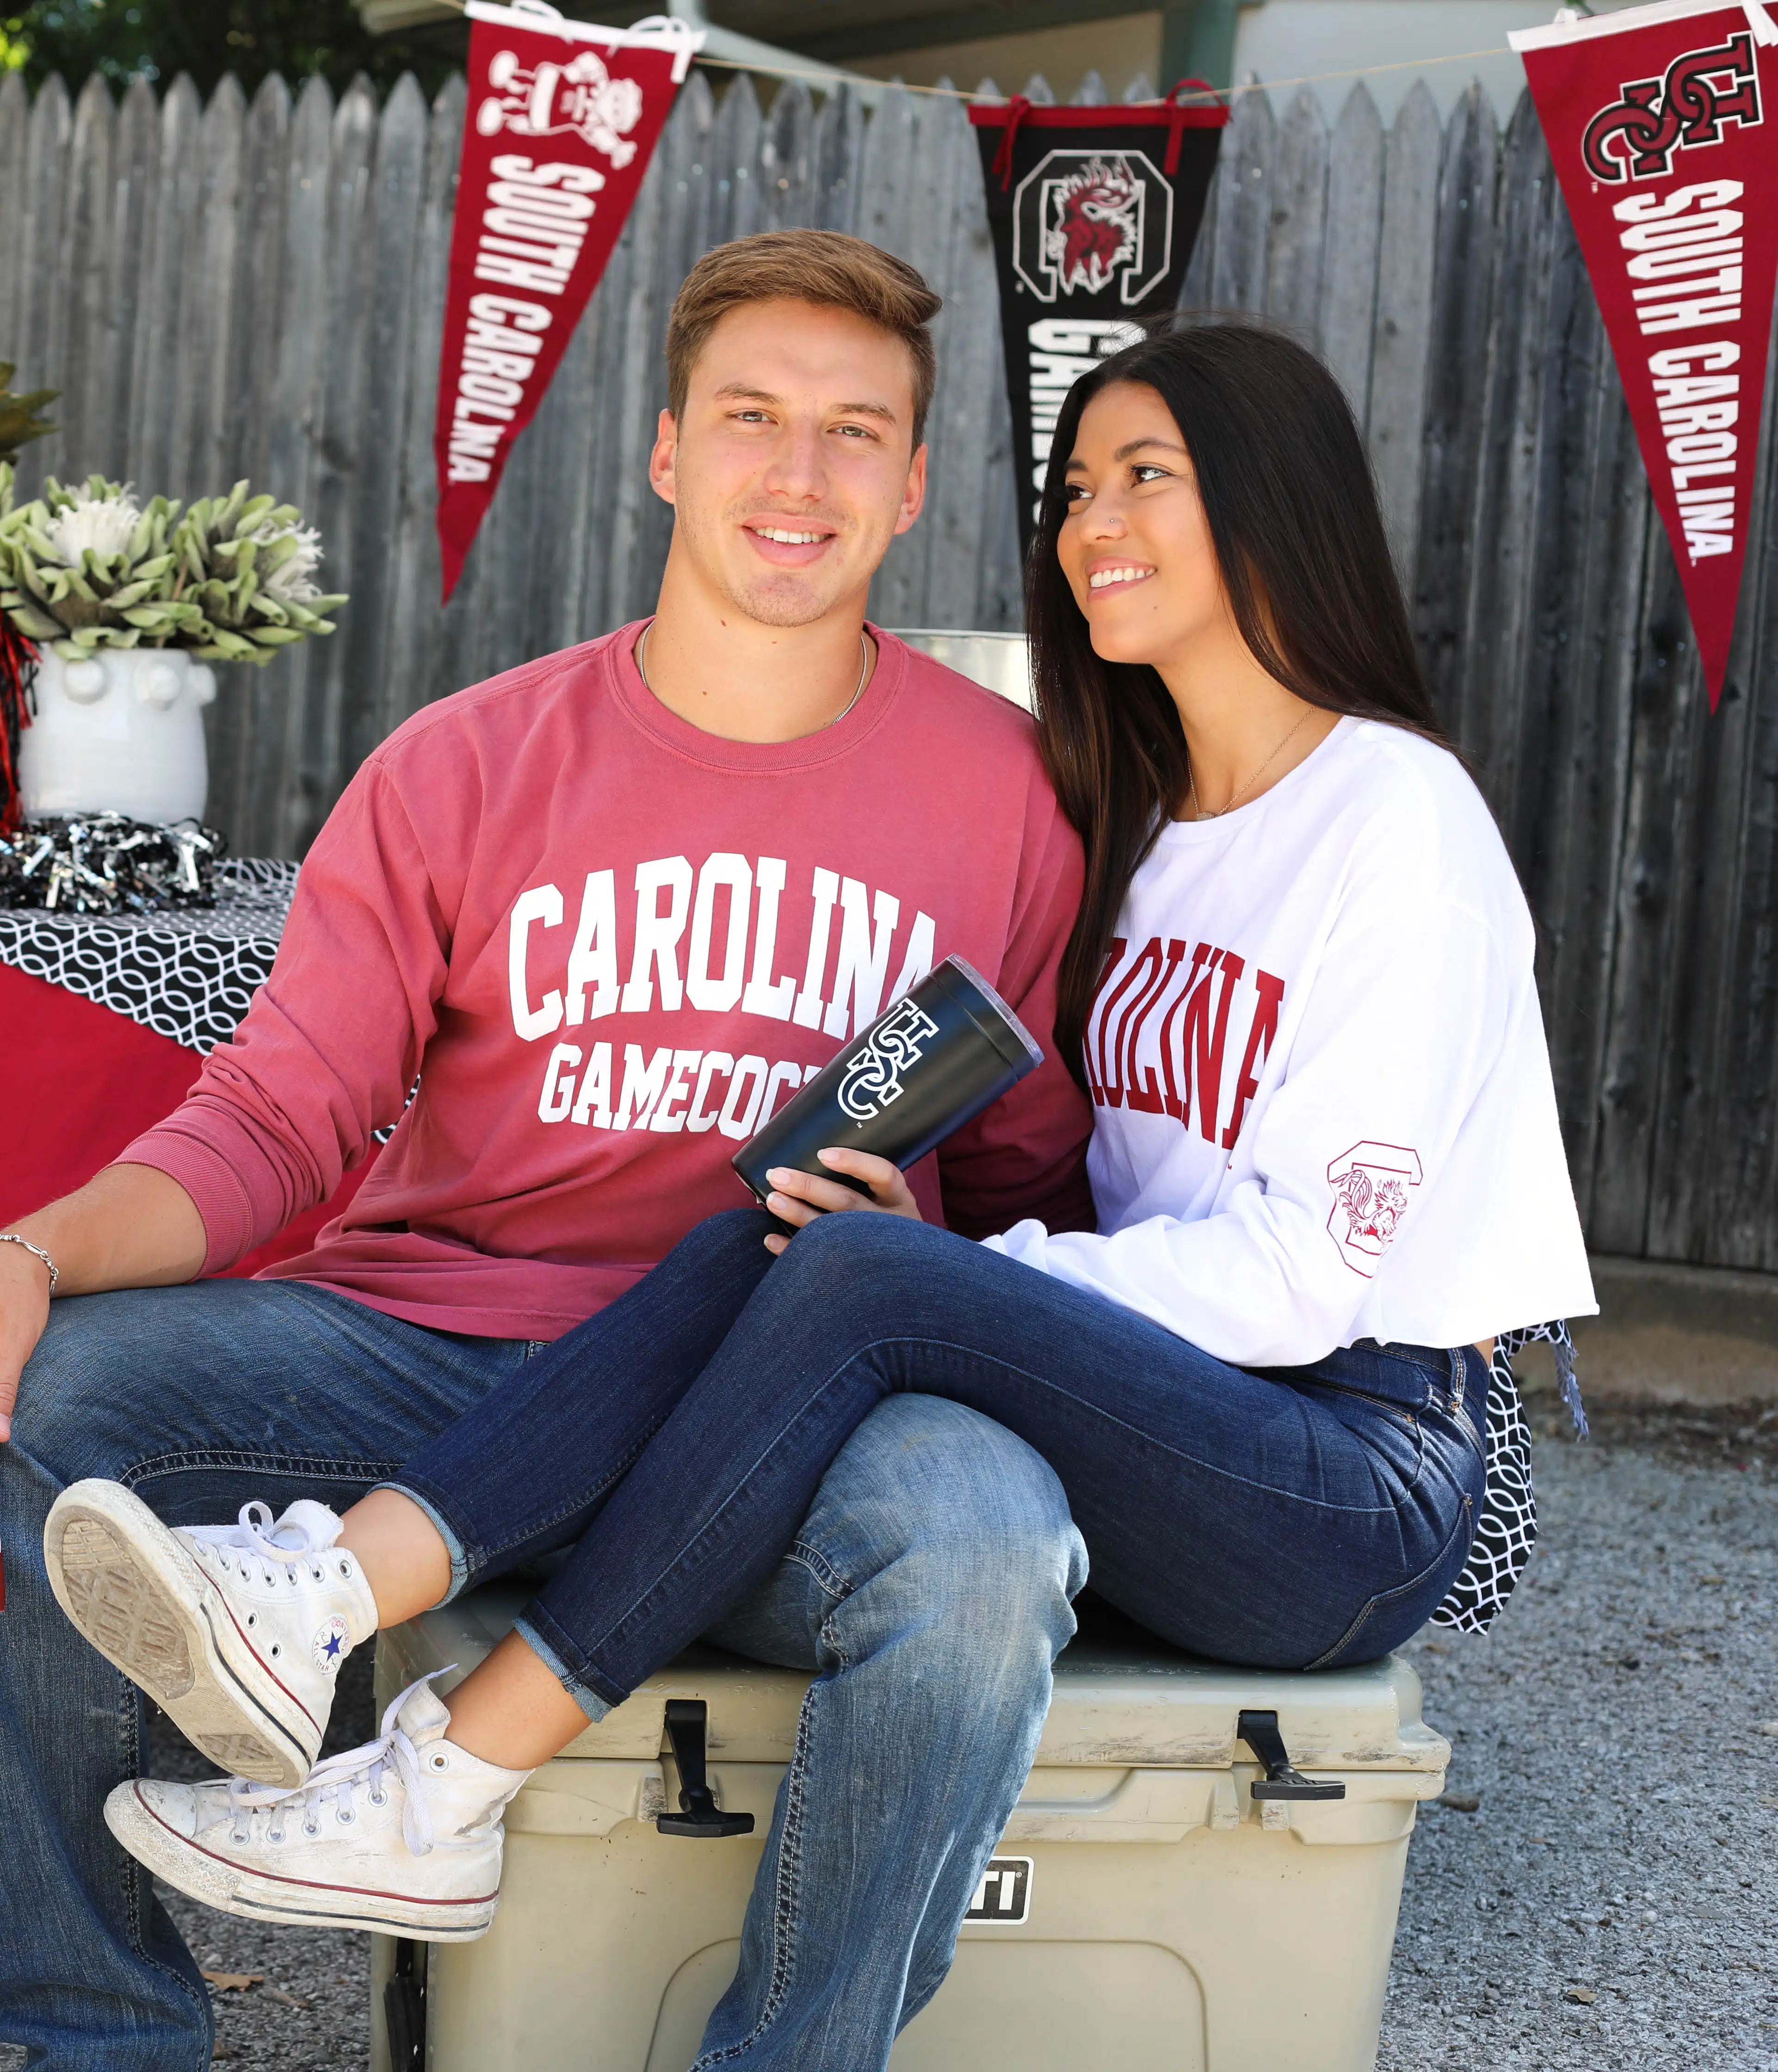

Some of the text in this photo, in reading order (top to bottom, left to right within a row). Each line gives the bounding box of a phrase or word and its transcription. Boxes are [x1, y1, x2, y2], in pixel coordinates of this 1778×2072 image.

[447, 154, 606, 482] SOUTH CAROLINA
[1611, 179, 1744, 558] SOUTH CAROLINA
[508, 852, 936, 1042] CAROLINA
[537, 1042, 823, 1141] GAMECOC
[315, 1659, 329, 1671] STAR
